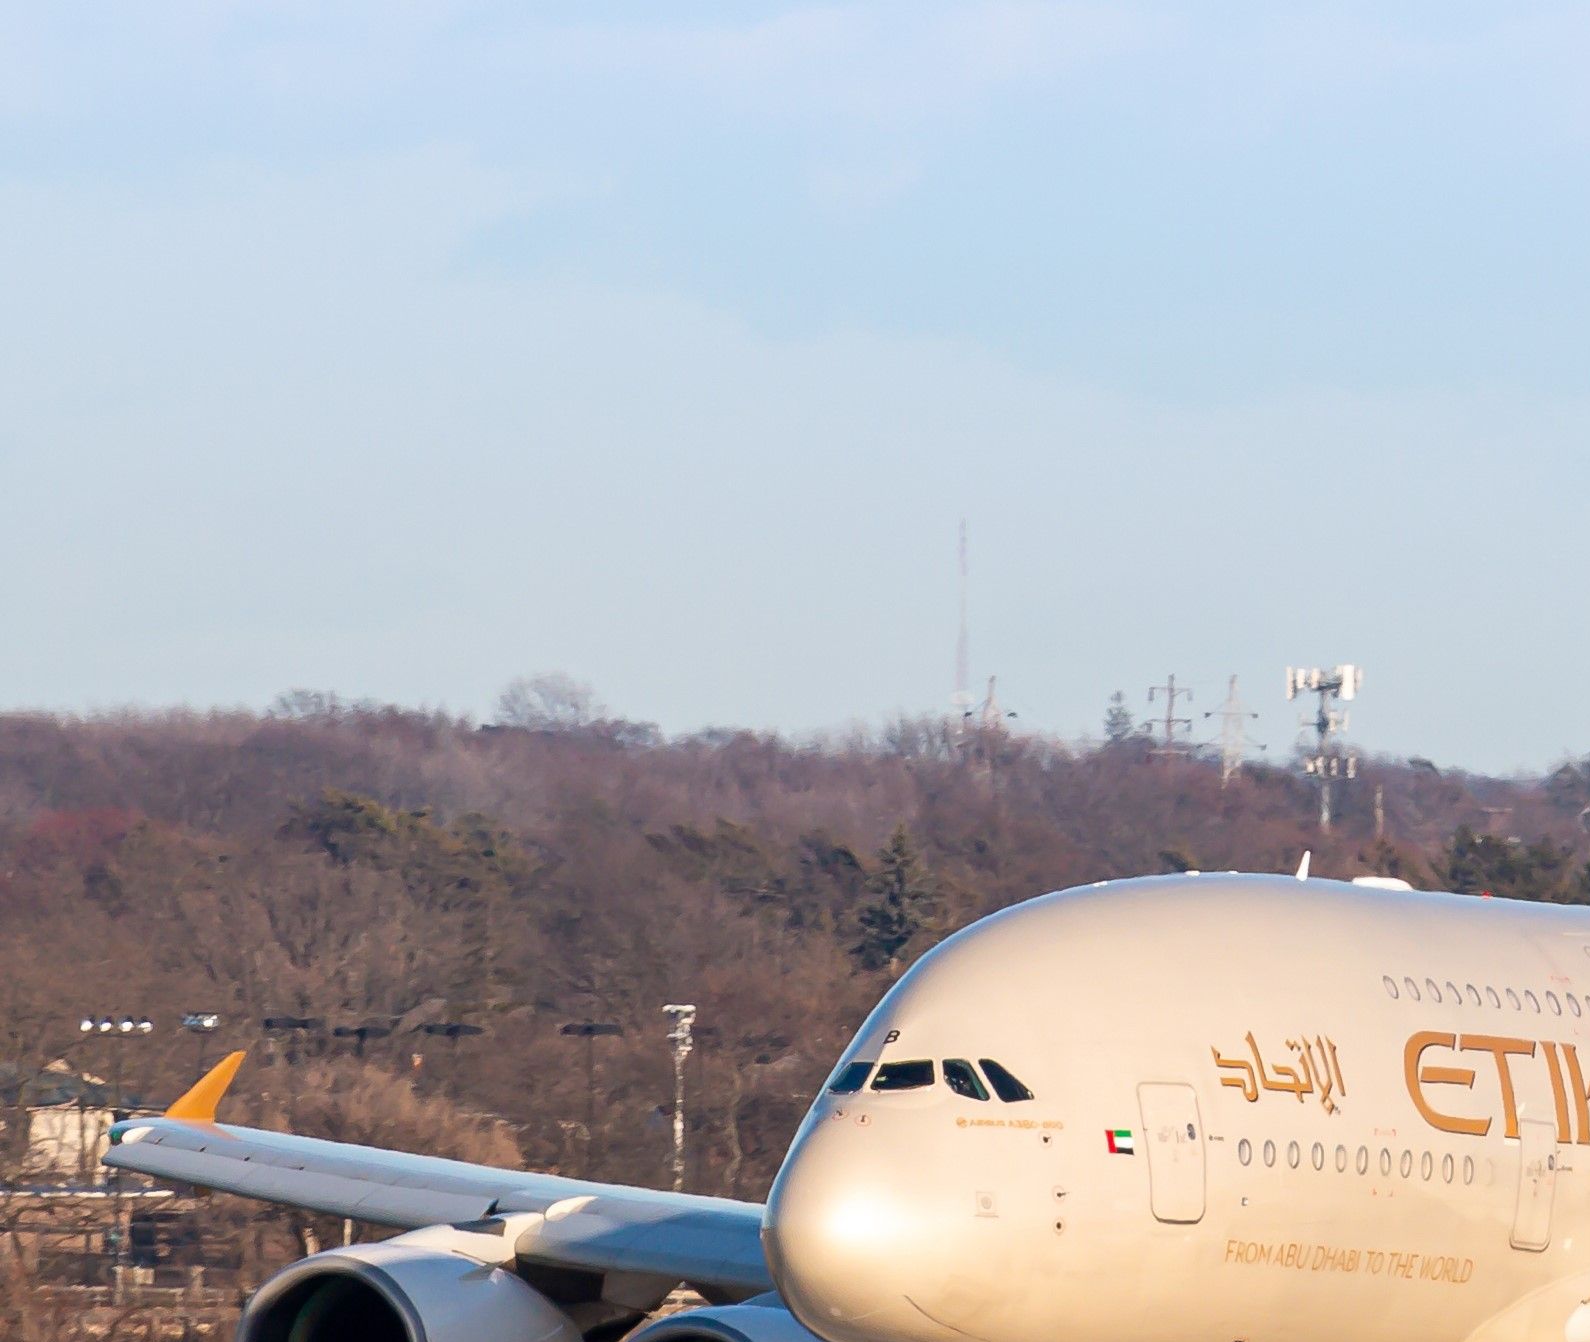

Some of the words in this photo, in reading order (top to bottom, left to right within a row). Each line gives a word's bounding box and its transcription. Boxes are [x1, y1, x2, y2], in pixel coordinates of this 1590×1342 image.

[1225, 1239, 1273, 1265] FROM
[1273, 1243, 1312, 1269] ABU
[1312, 1245, 1362, 1273] DHABI
[1366, 1250, 1385, 1275] TO
[1387, 1252, 1420, 1279] THE
[1419, 1255, 1474, 1284] WORLD
